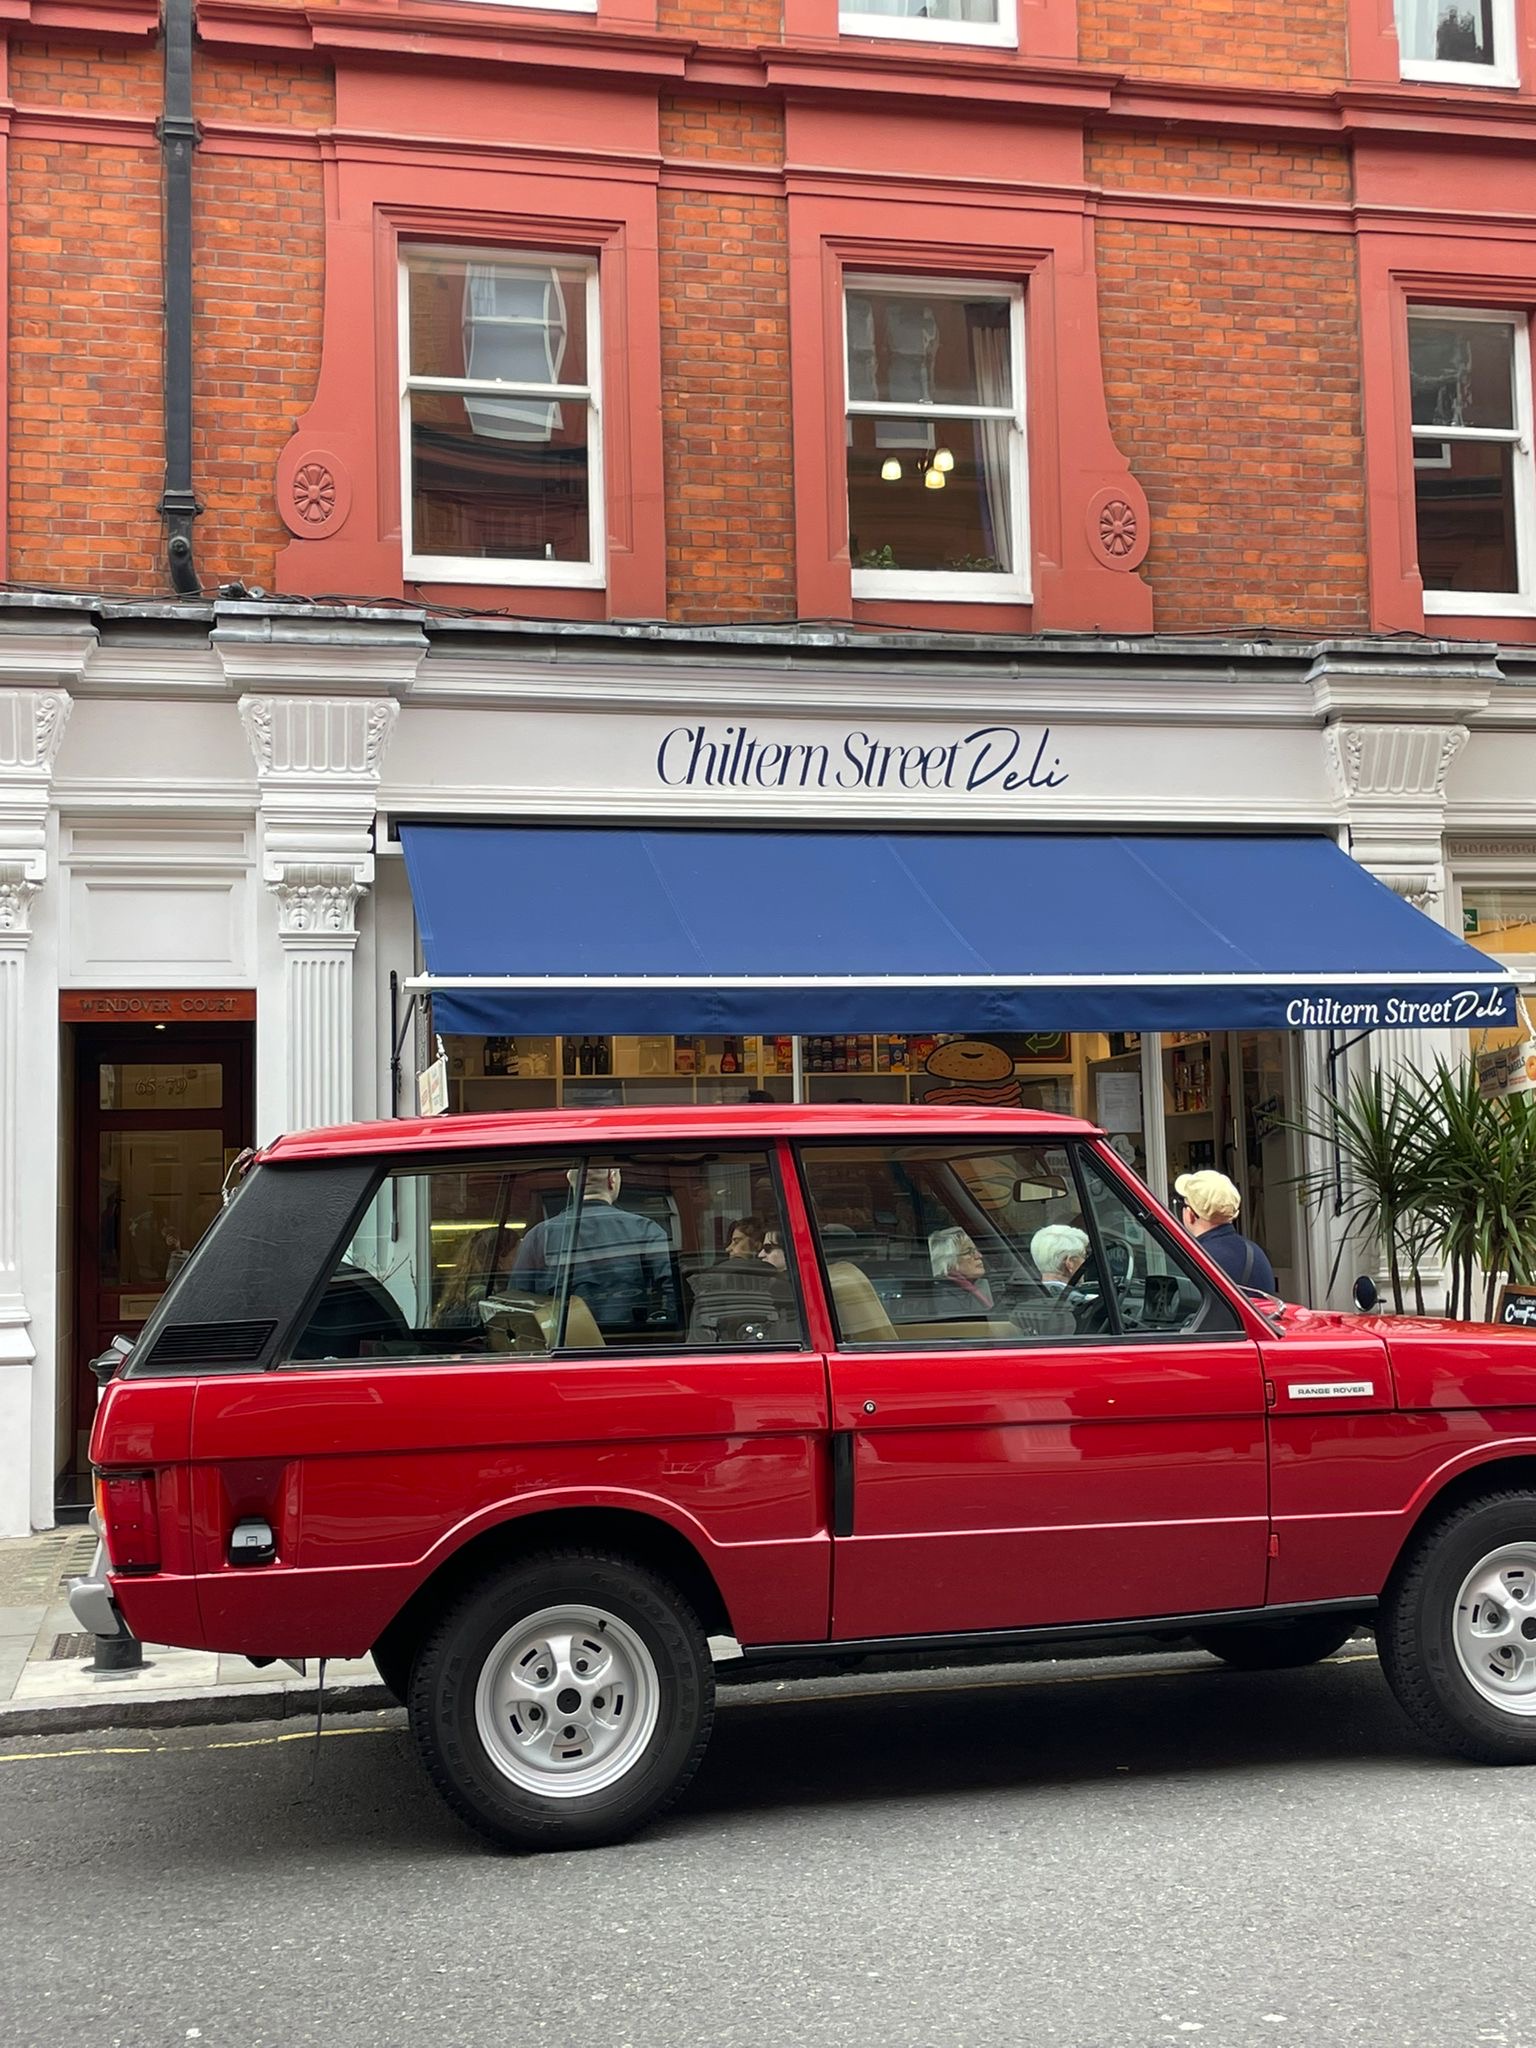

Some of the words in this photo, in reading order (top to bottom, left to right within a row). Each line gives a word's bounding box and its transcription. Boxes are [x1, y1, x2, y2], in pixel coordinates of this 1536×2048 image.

[657, 726, 829, 787] Chiltern
[836, 731, 962, 789] Street
[964, 727, 1070, 791] Deli
[80, 998, 172, 1013] WENDOVER
[180, 997, 238, 1013] COURT
[1286, 997, 1380, 1026] Chiltern
[1384, 997, 1453, 1024] Street
[1451, 986, 1508, 1023] Deli
[135, 1076, 189, 1097] 65-79
[1297, 1387, 1331, 1395] RANGE
[1333, 1386, 1366, 1394] ROVER
